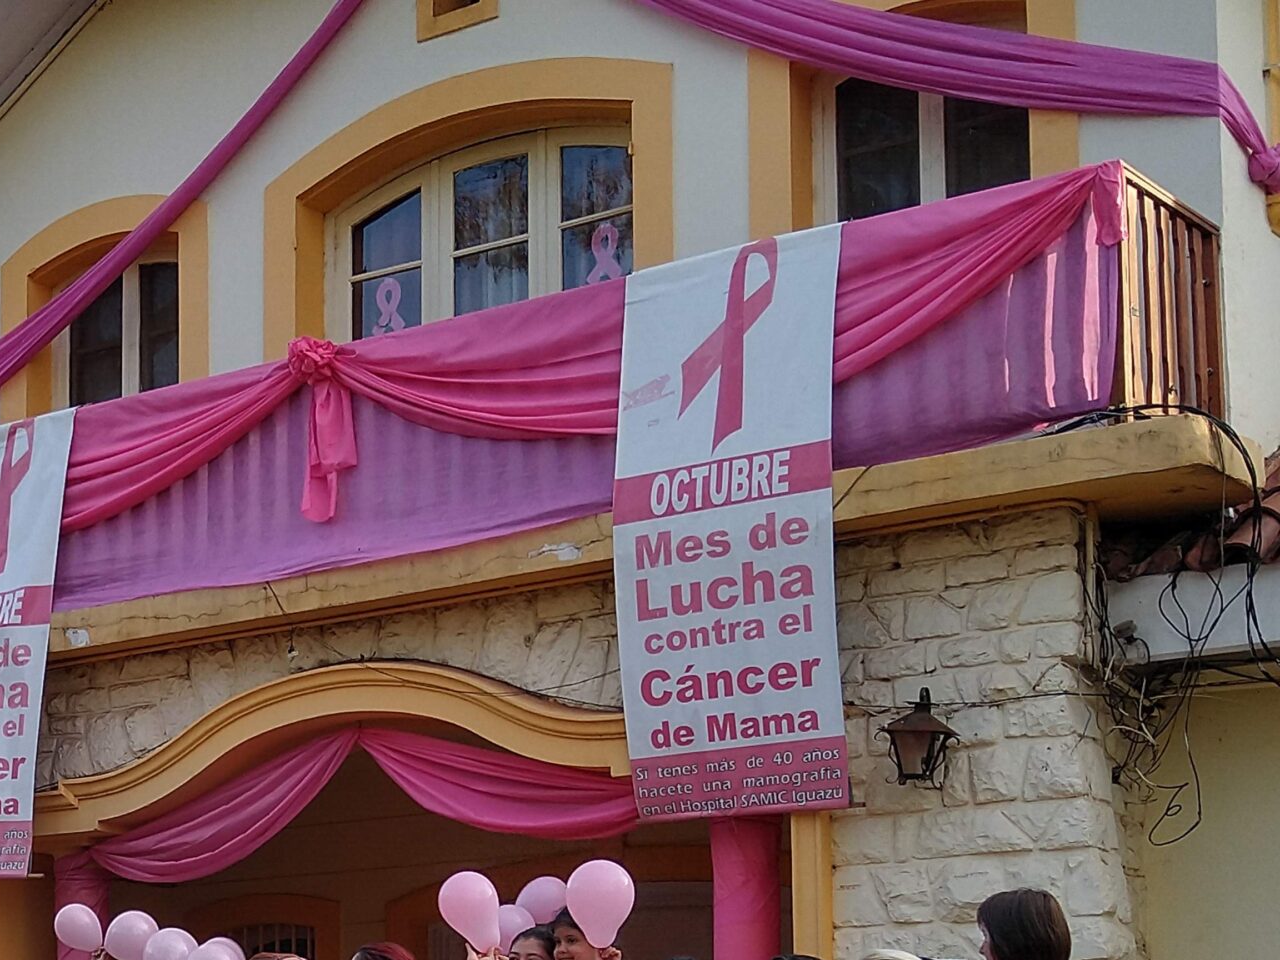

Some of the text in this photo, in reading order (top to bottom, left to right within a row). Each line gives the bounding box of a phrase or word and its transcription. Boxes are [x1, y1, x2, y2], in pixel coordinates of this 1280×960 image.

[650, 450, 790, 516] OCTUBRE
[634, 512, 810, 571] Mes de
[634, 561, 815, 621] Lucha
[644, 603, 813, 655] contra el
[640, 658, 821, 707] Cáncer
[2, 714, 25, 738] el
[650, 708, 820, 750] de Mama
[657, 763, 699, 779] tenes
[746, 755, 764, 769] de
[772, 751, 793, 765] 40
[802, 746, 840, 763] años
[638, 782, 693, 799] hacete
[702, 778, 732, 792] una
[643, 804, 661, 816] en
[664, 801, 677, 814] el
[679, 795, 738, 814] Hospital
[740, 790, 788, 808] SAMIC
